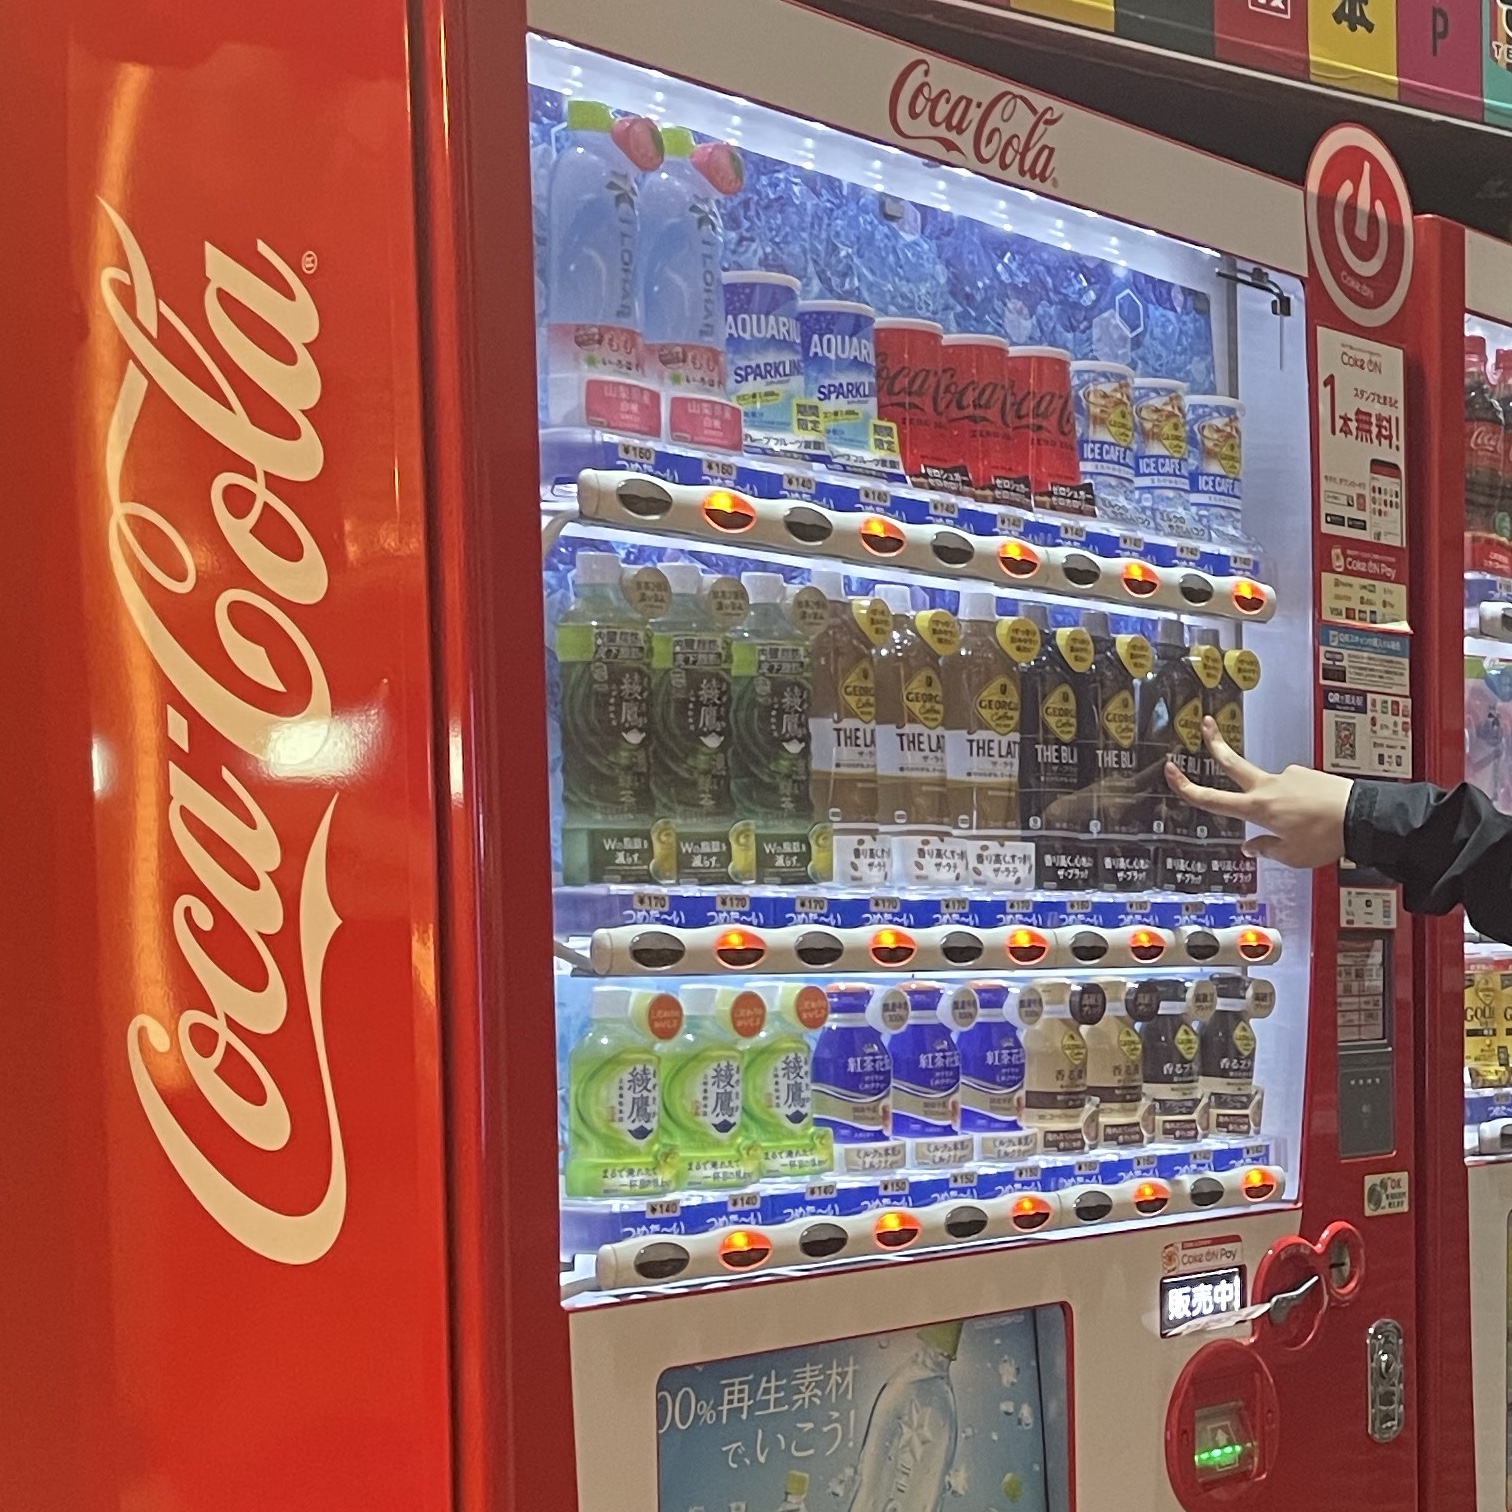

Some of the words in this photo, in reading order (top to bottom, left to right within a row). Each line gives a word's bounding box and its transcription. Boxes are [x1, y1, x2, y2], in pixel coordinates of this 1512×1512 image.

[888, 58, 1060, 187] Coca-Cola
[1084, 442, 1101, 459] ICE
[1139, 458, 1156, 474] ICE
[92, 193, 348, 1265] Coca-Cola
[833, 727, 862, 750] THE
[896, 732, 927, 752] THE
[966, 738, 995, 759] THE
[1035, 743, 1059, 763] THE
[1096, 749, 1119, 769] THE
[637, 895, 667, 909] ¥170
[719, 895, 748, 908] ¥170
[710, 1060, 736, 1119] 綾鷹
[780, 1051, 807, 1109] 綾鷹
[626, 1064, 653, 1125] 綾鷹
[650, 1202, 678, 1215] ¥140
[731, 1195, 758, 1208] ¥140
[1220, 1247, 1238, 1261] Pay
[1168, 1278, 1234, 1321] 販売中
[721, 1409, 856, 1470] で、いこう!
